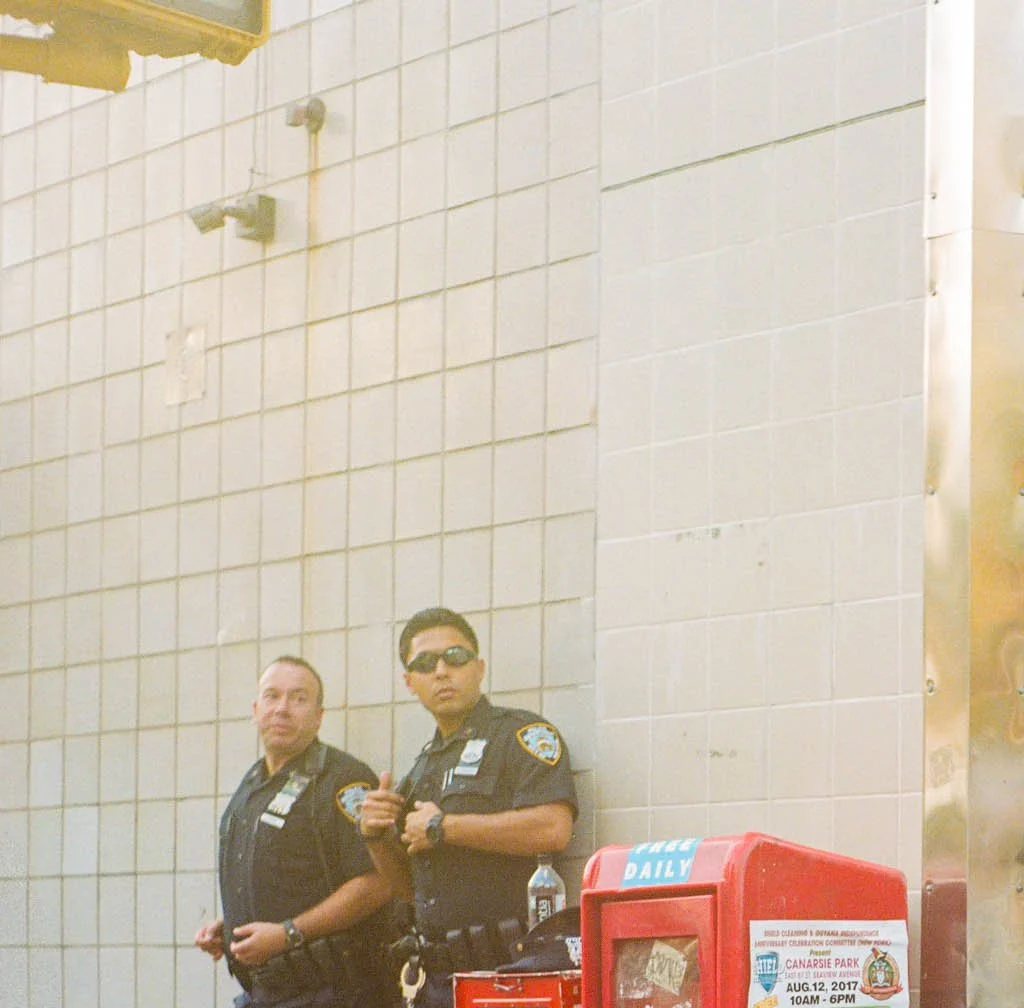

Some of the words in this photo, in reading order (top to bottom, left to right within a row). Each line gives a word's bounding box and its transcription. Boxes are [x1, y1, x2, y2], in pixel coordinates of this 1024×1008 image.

[623, 857, 694, 880] DAILY
[788, 939, 824, 947] CELEBRATION
[809, 949, 831, 957] Present
[785, 959, 832, 970] CANARSIE
[834, 957, 860, 969] PARK
[786, 982, 828, 993] AUG.12,
[831, 981, 858, 991] 2017
[790, 995, 820, 1006] 10AM
[830, 994, 856, 1005] 6PM
